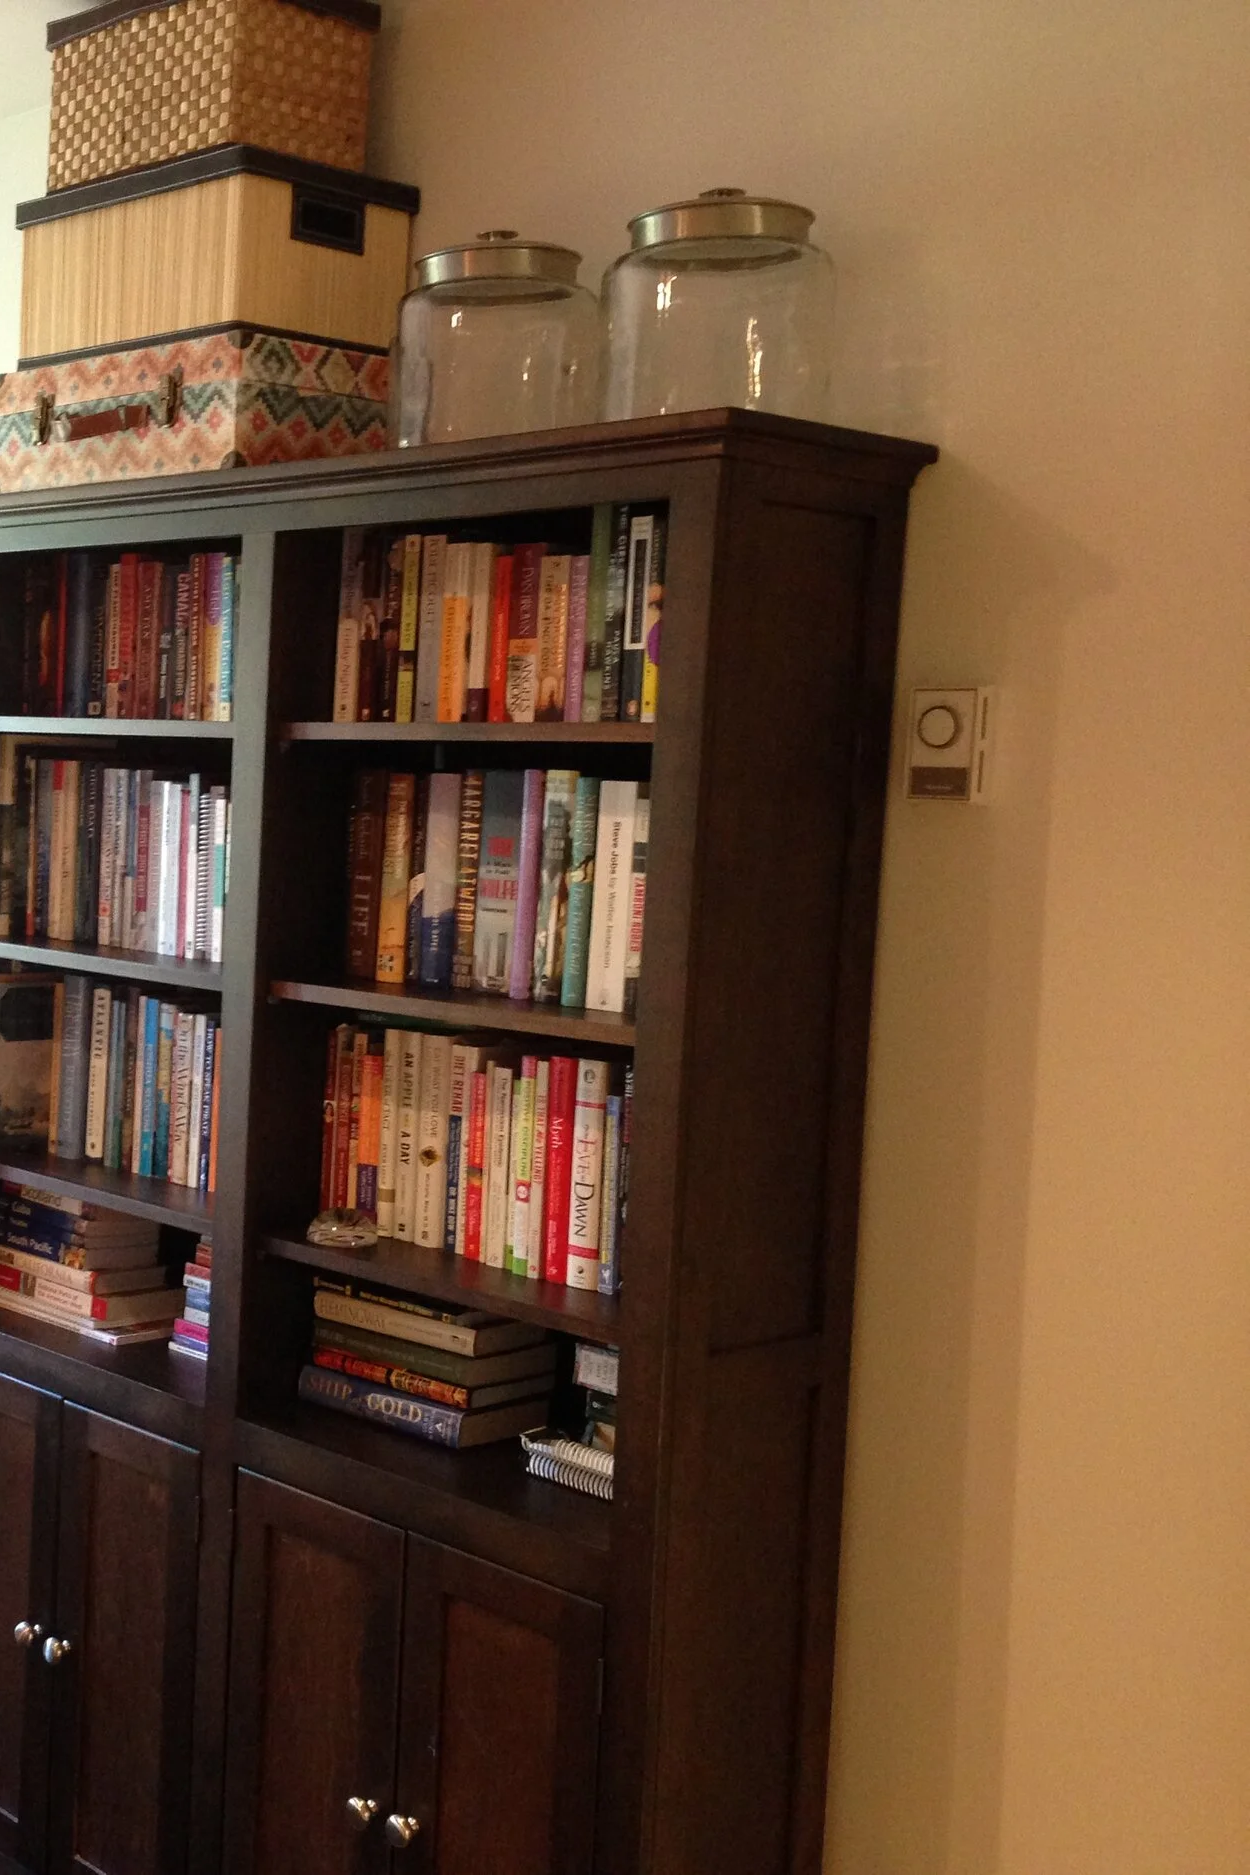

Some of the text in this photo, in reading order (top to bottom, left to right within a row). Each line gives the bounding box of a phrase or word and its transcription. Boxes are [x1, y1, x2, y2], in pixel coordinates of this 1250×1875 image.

[617, 535, 627, 566] GIRL
[143, 586, 152, 611] AMY
[519, 568, 534, 635] DAN BROWN
[141, 617, 151, 640] TAN
[91, 606, 104, 693] DIVERGENT
[612, 630, 621, 664] PAULA
[220, 640, 231, 700] Patchett
[338, 627, 352, 700] Friday Nights
[603, 641, 613, 690] HAWKINS
[521, 661, 533, 714] ANGELS
[351, 874, 374, 937] LIFE
[458, 866, 476, 933] ATWOOD
[603, 821, 622, 969] Steve Jobs by Walter Isaacson
[571, 912, 583, 940] Third
[629, 877, 646, 952] ZAMBONI RODEO
[569, 943, 582, 974] Child
[94, 994, 106, 1061] ATLANTIC
[180, 1019, 190, 1037] On
[178, 1045, 189, 1065] the
[403, 1052, 415, 1068] AN
[454, 1056, 466, 1078] DIET
[201, 1029, 215, 1136] HOW TO SPEAK PIRATE
[401, 1071, 414, 1108] APPLE
[431, 1066, 440, 1090] WHAT
[498, 1078, 506, 1090] The
[624, 1072, 635, 1097] SYBIL
[430, 1094, 439, 1112] YOU
[452, 1080, 465, 1112] REHAB
[174, 1114, 187, 1146] Way
[429, 1114, 439, 1138] LOVE
[474, 1105, 484, 1128] FOOD
[519, 1081, 532, 1179] POSITIVE DISCIPLINE
[536, 1107, 546, 1127] THAT
[550, 1116, 564, 1149] Myth
[399, 1143, 411, 1165] DAY
[473, 1131, 483, 1164] NATION
[493, 1134, 505, 1168] Epidemic
[447, 1199, 457, 1215] MIKE
[574, 1182, 596, 1238] DAWN
[8, 1233, 53, 1255] South Pacific
[318, 1296, 387, 1329] HEMINGWAY
[307, 1375, 423, 1423] SHIP GOLD
